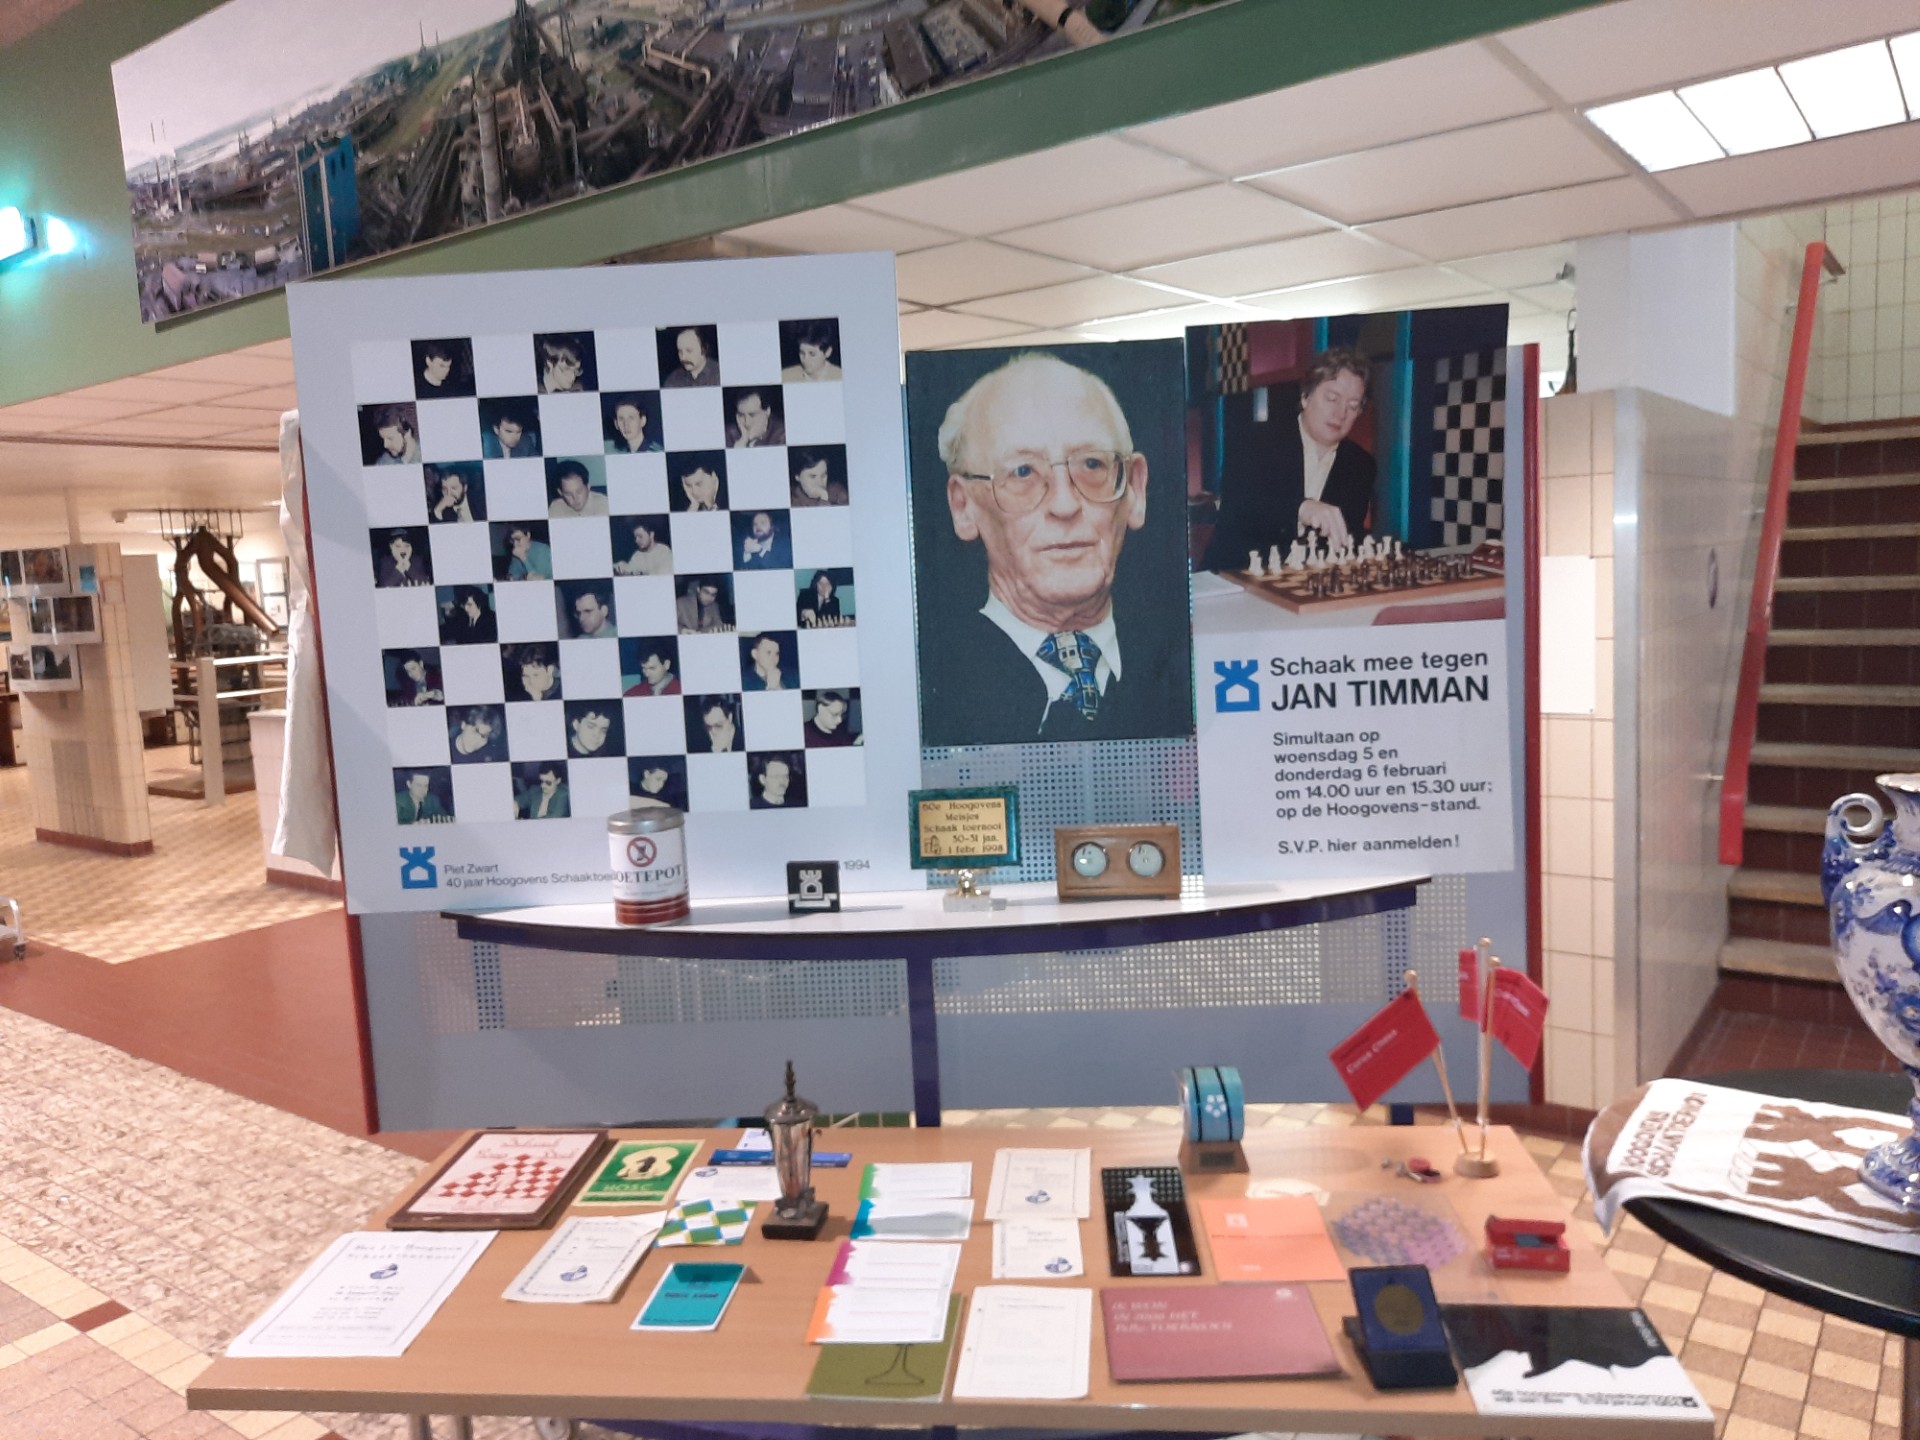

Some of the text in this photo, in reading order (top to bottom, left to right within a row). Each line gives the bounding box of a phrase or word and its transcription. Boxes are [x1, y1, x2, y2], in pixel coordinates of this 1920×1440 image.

[1270, 652, 1488, 676] Schaak mee tegen
[1271, 675, 1489, 711] JAN TIMMAN
[1273, 731, 1380, 746] Simultaan op
[1274, 746, 1398, 764] woensdag 5 en
[1275, 761, 1447, 782] donderdag 6 februari
[1275, 789, 1300, 800] om
[1305, 784, 1350, 798] 14.00
[1354, 786, 1381, 797] uur
[1386, 785, 1406, 795] en
[1411, 779, 1455, 794] 15.30
[949, 801, 1002, 811] Hoogovens
[1276, 797, 1481, 820] op de Hoogovens-stand.
[963, 823, 1001, 831] toernooi
[1278, 840, 1323, 855] S.V.P.
[1327, 838, 1357, 852] hier
[444, 863, 498, 875] Piet Zwart
[446, 877, 462, 888] 40
[463, 878, 484, 889] jaar
[486, 876, 549, 888] Hoogovens
[843, 859, 870, 870] 1994
